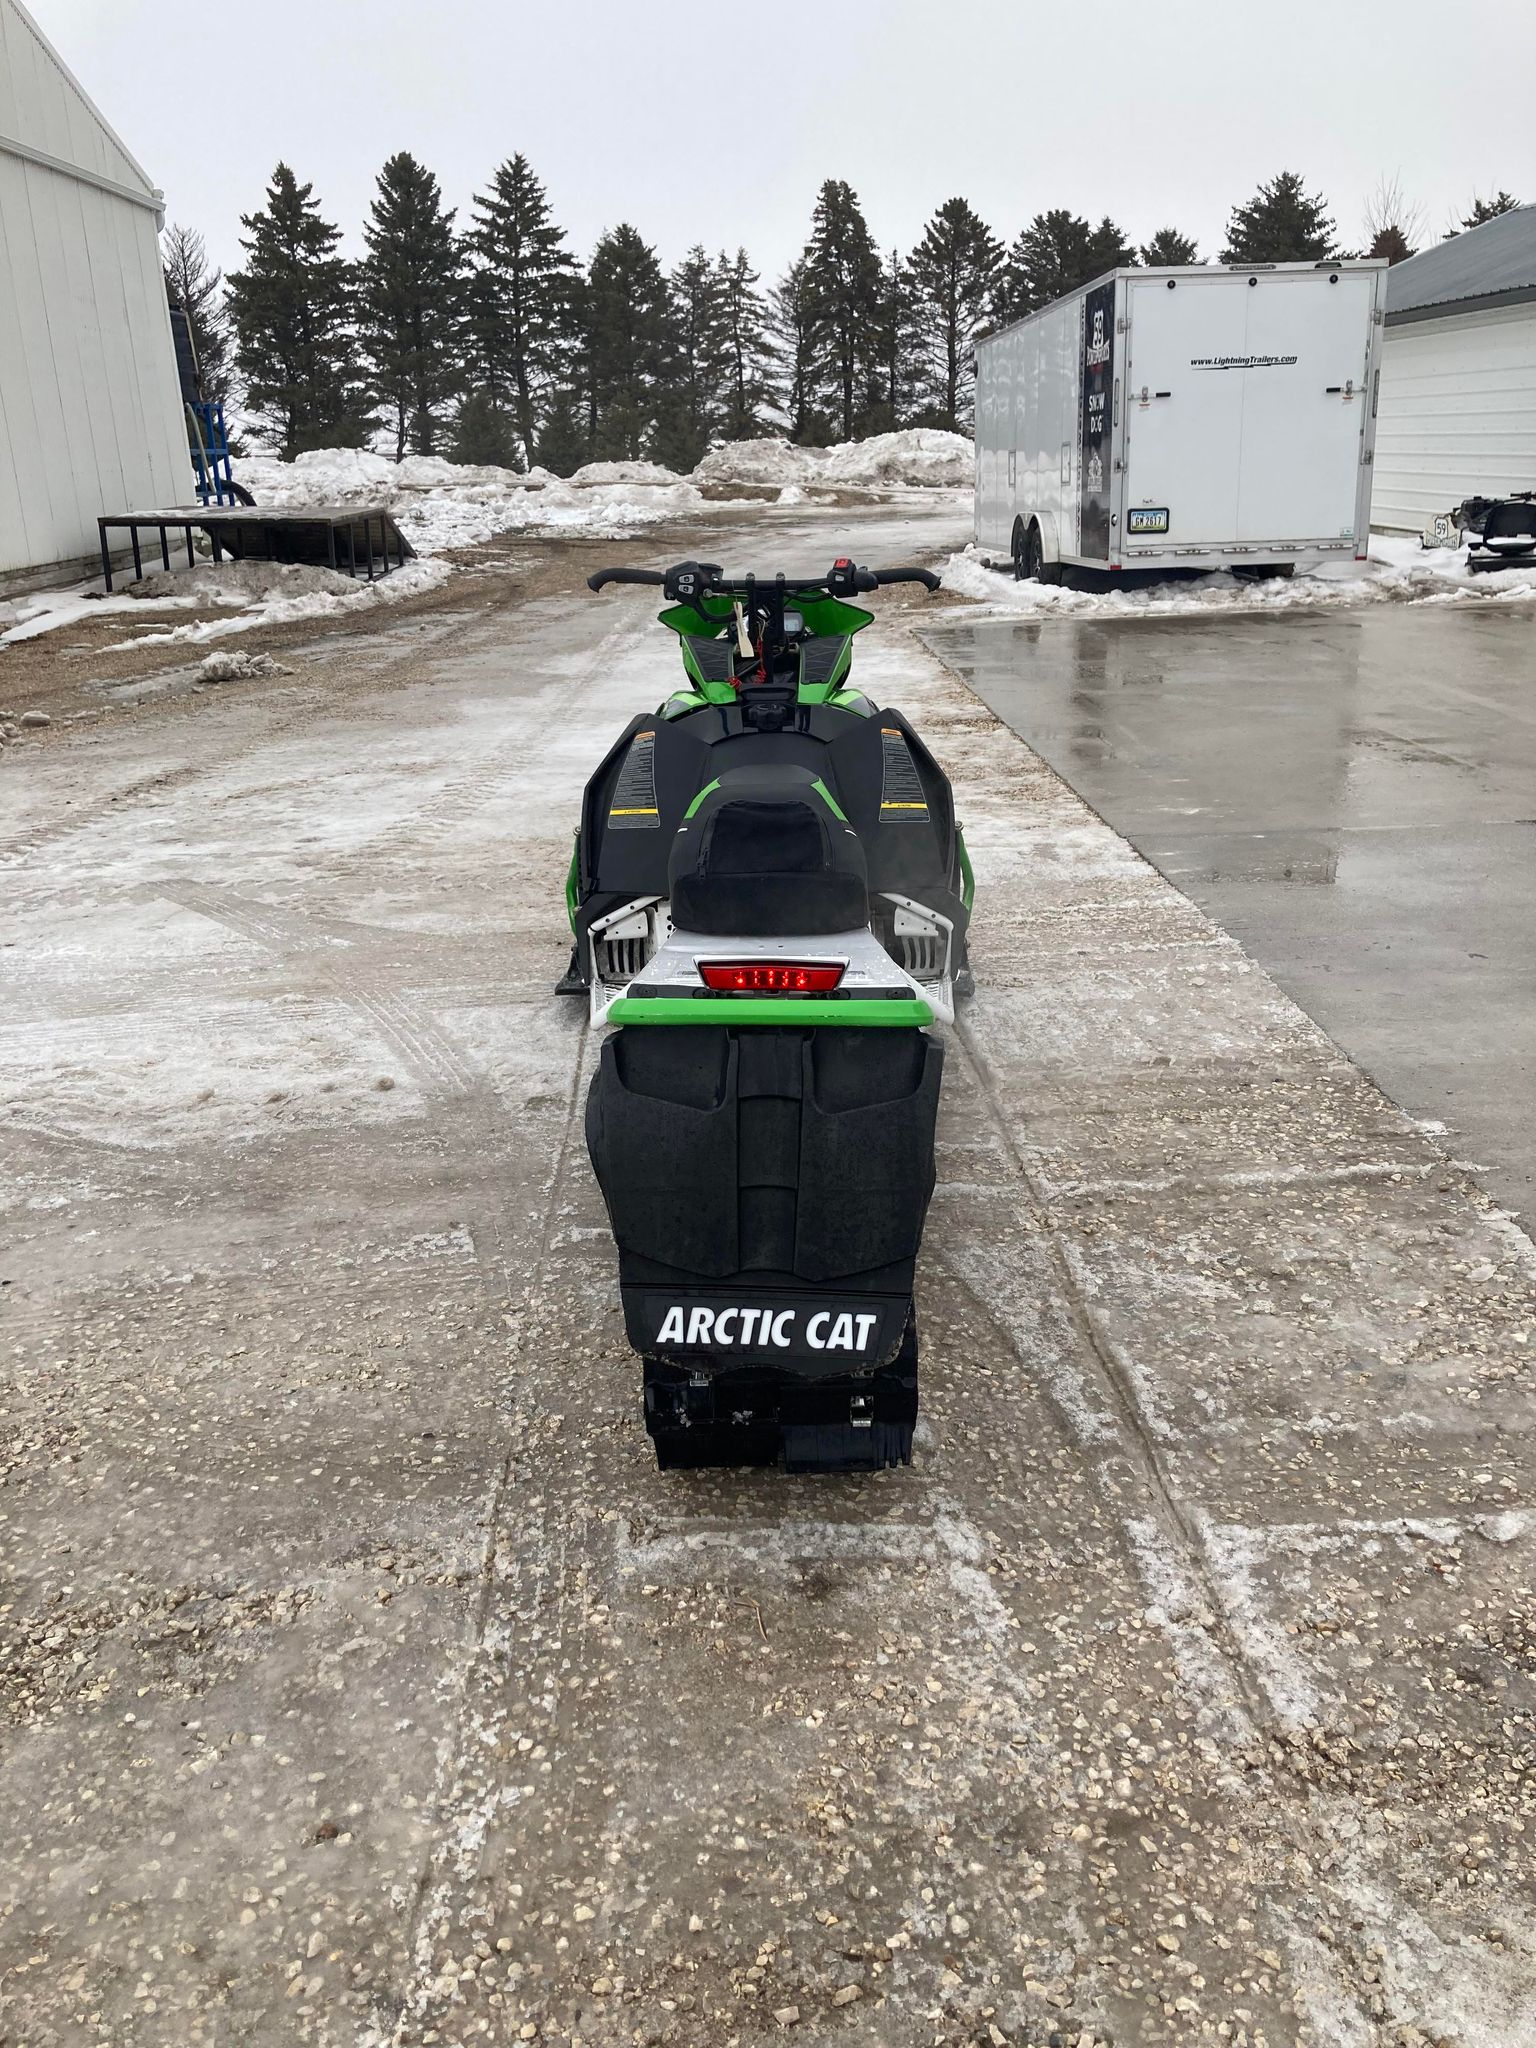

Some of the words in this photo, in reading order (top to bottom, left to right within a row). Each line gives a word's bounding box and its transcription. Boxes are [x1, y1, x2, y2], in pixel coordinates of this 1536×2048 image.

[1190, 355, 1298, 366] www.LightningTrailers.com
[1089, 392, 1105, 412] SNOW
[1090, 415, 1103, 433] DOG
[1437, 523, 1446, 535] 59
[656, 1306, 796, 1348] ARCTIC
[805, 1311, 877, 1351] CAT
